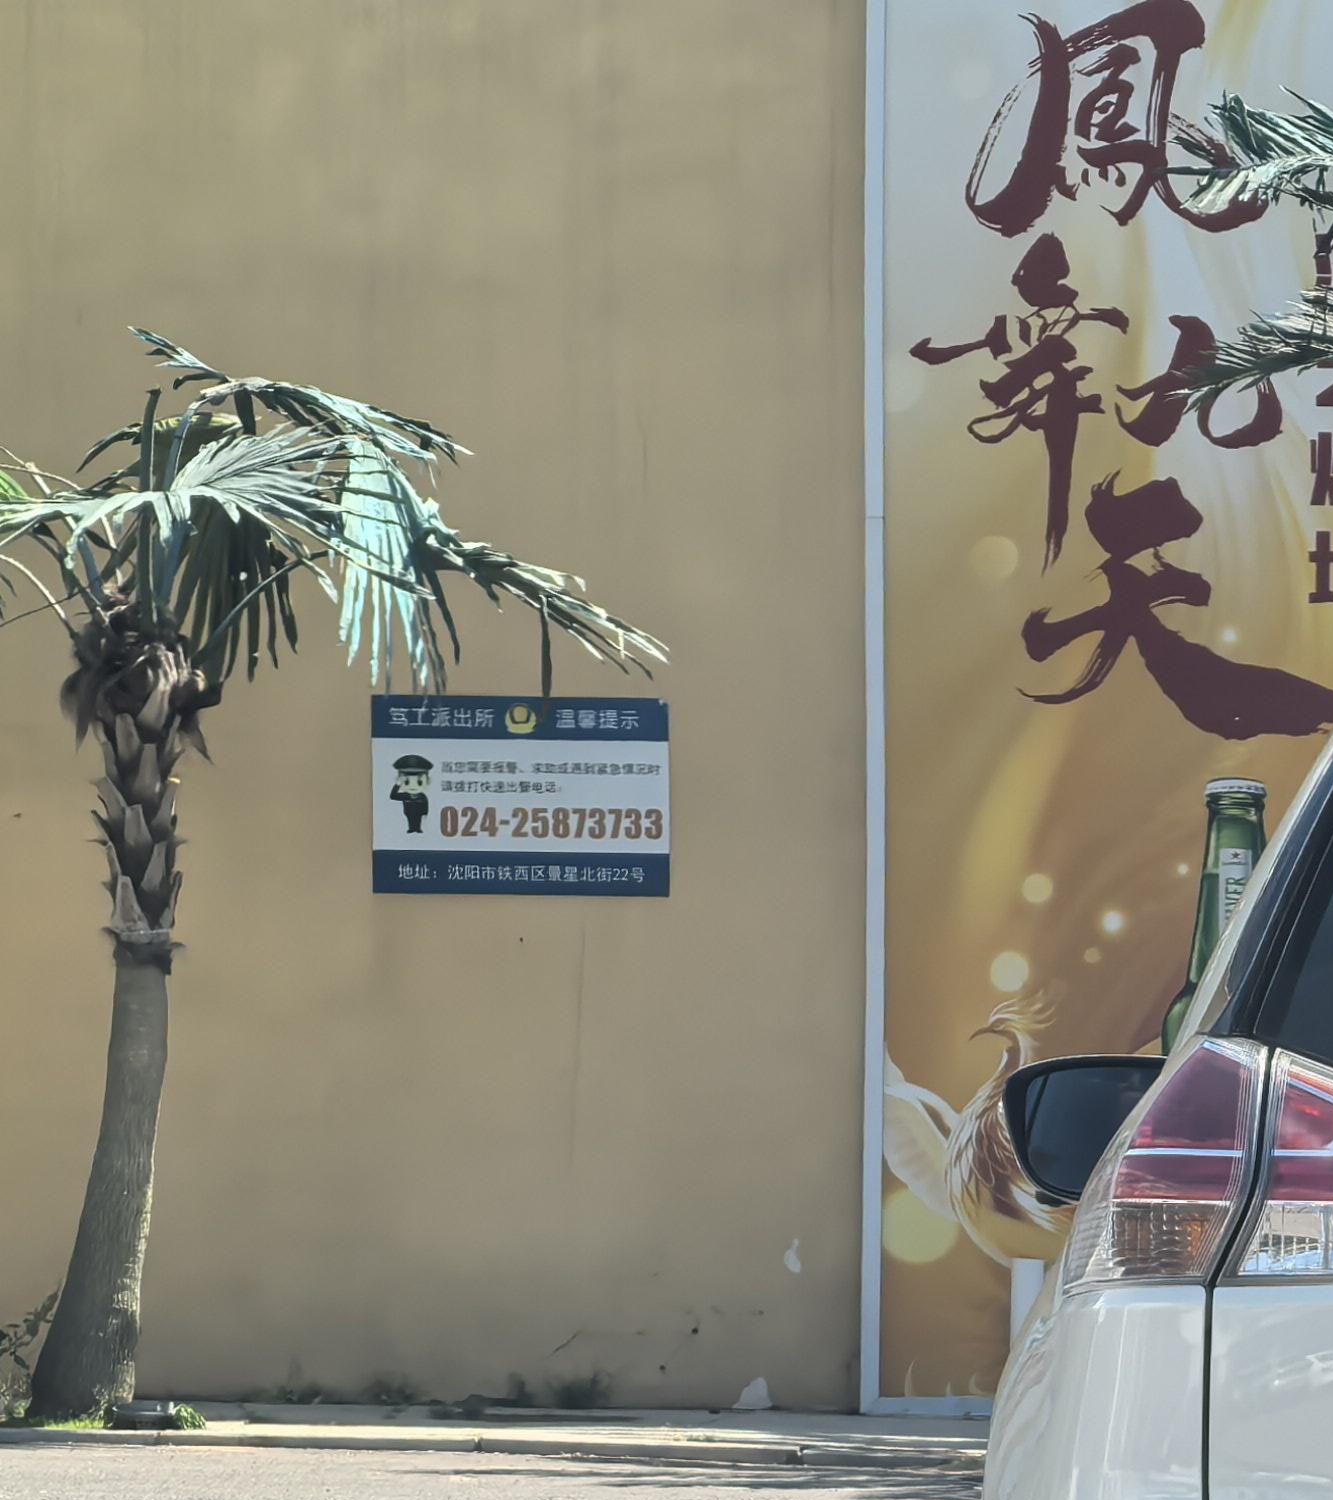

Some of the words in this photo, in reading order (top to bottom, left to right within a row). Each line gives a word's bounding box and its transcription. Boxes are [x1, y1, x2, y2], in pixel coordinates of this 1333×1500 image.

[555, 708, 640, 730] 温馨提示
[440, 805, 664, 840] 024-25873733
